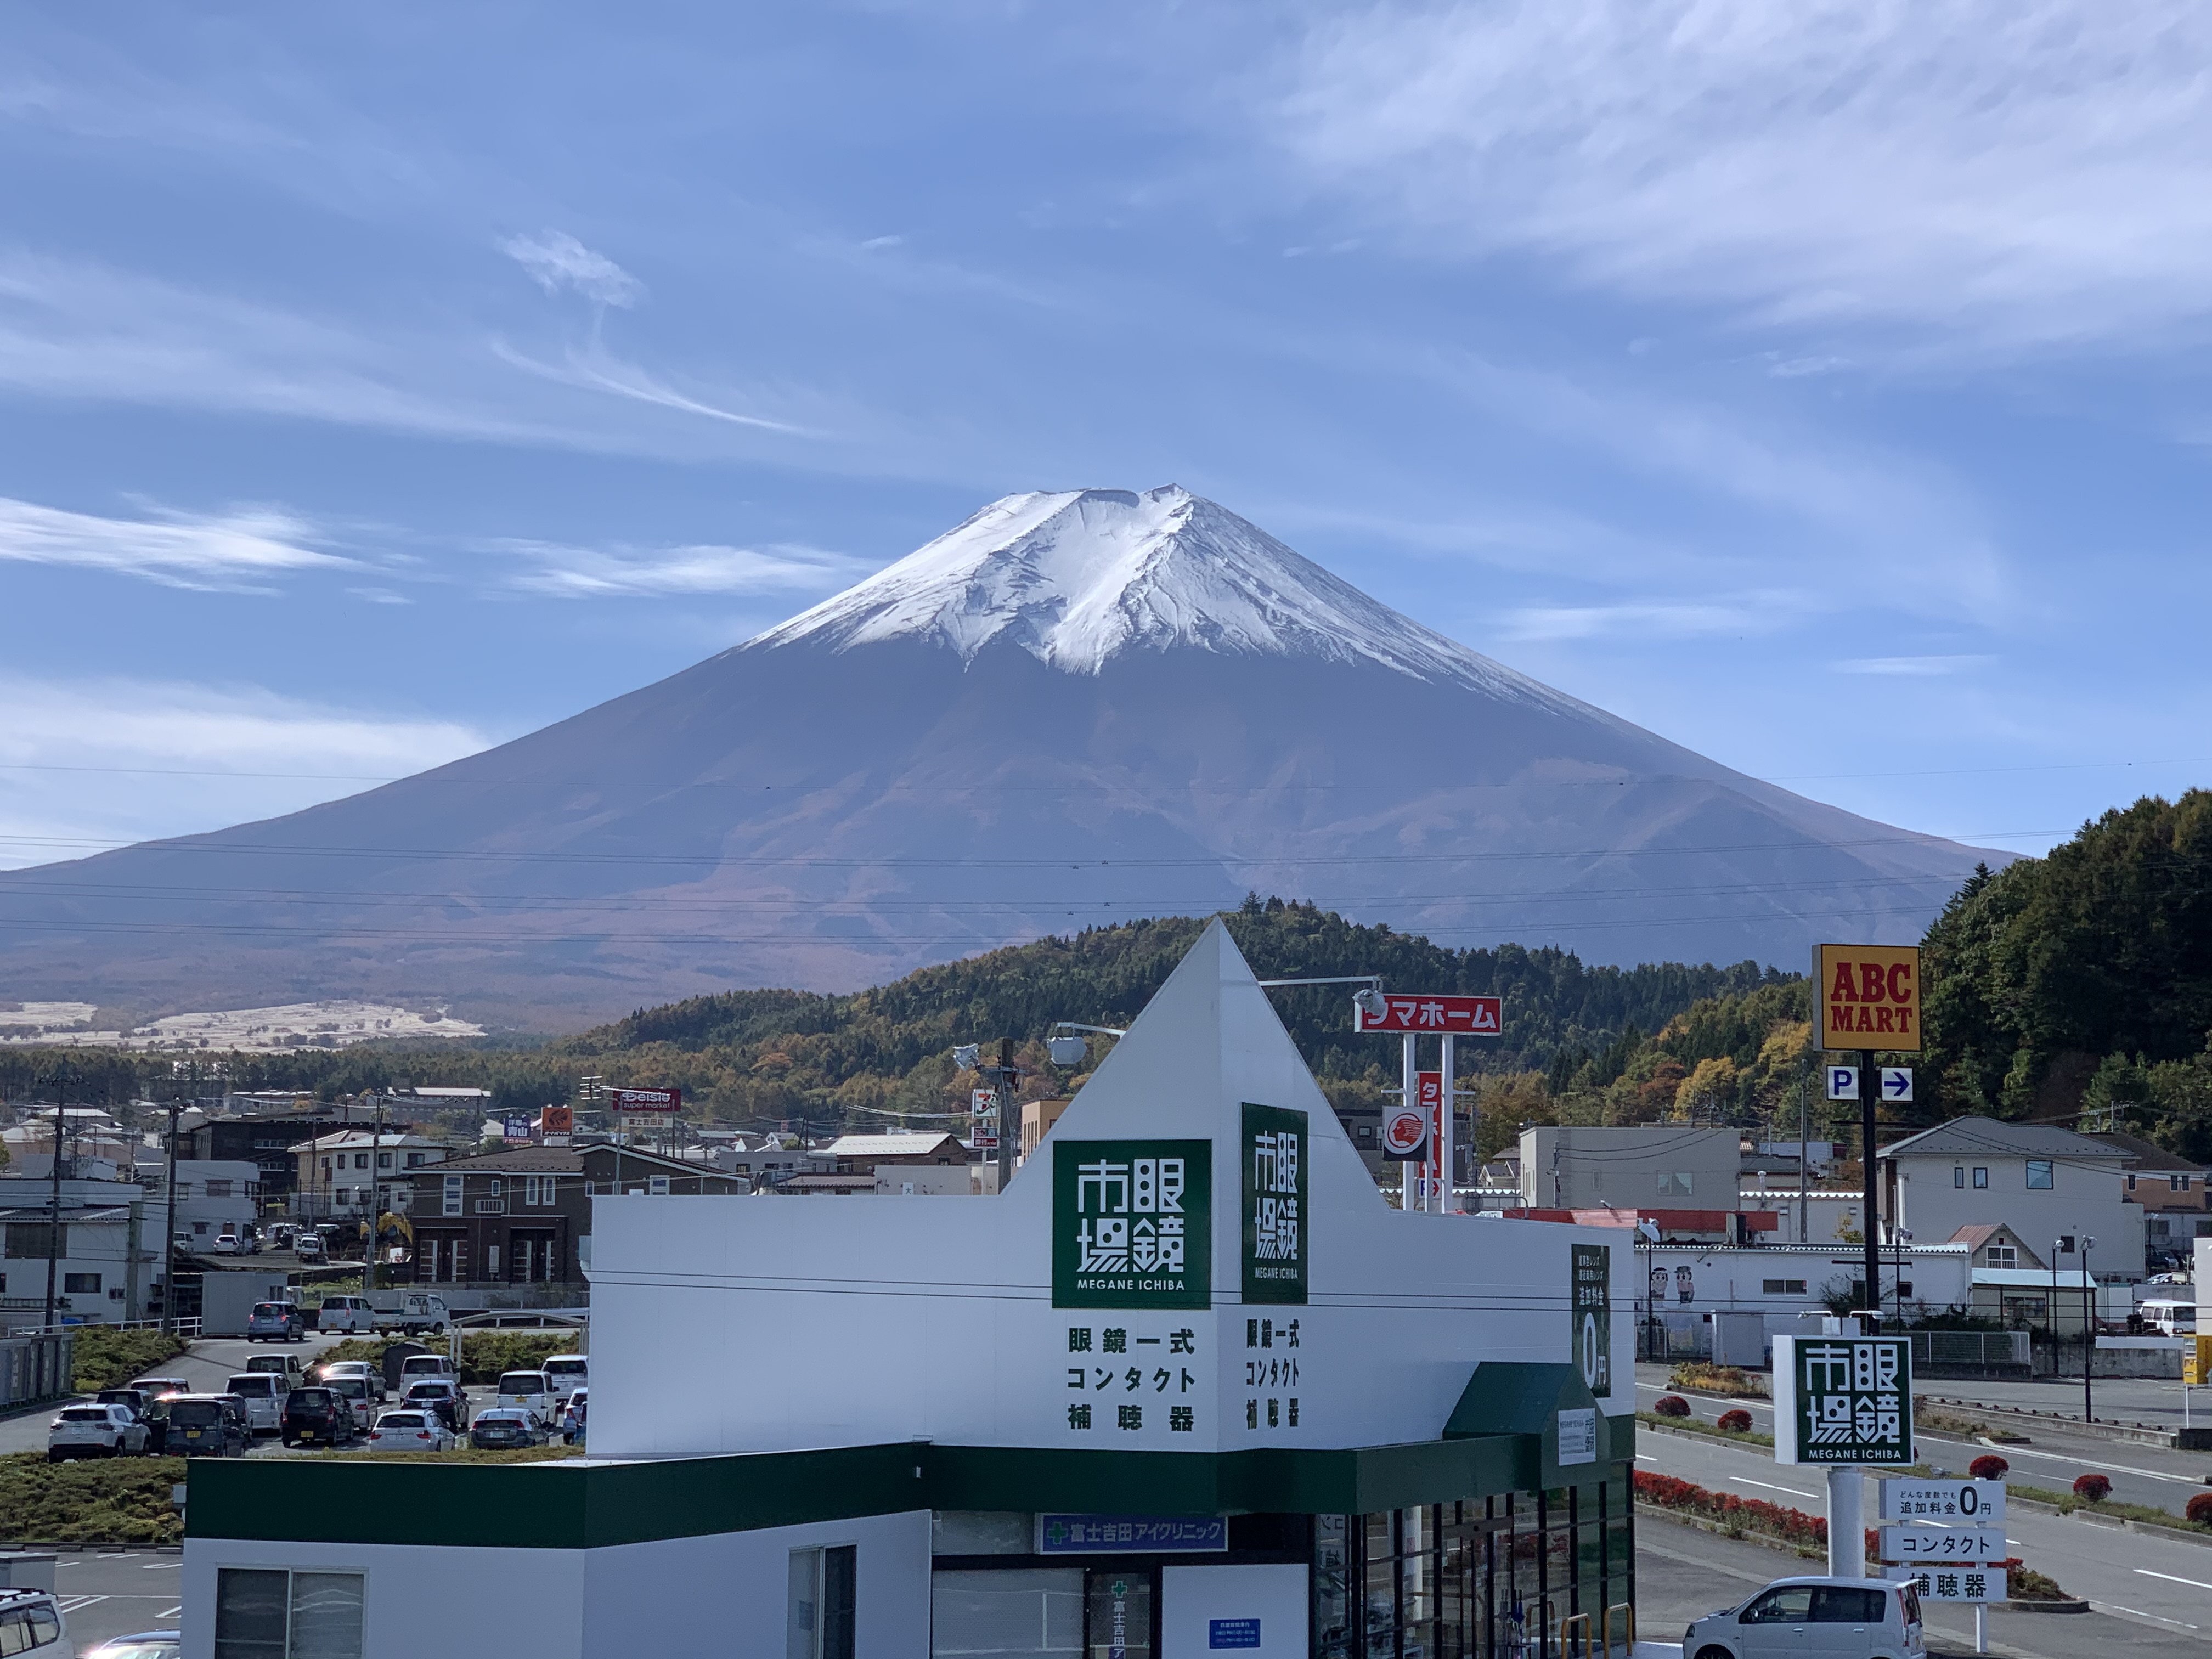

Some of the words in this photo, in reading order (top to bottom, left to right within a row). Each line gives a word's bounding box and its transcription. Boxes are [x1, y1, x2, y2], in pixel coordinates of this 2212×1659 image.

[1831, 963, 1911, 1003] ABC
[1831, 1006, 1912, 1033] MART
[1833, 1070, 1852, 1096] P
[1077, 1280, 1133, 1290] MEGANE
[1139, 1280, 1184, 1290] ICHIBA
[1255, 1267, 1278, 1279] MEGANE
[1280, 1268, 1298, 1279] ICHIBA
[1069, 1328, 1195, 1354] 眼鏡一式
[1247, 1319, 1299, 1348] 眼鏡一式
[1068, 1367, 1195, 1392] コンタクト
[1246, 1358, 1299, 1387] コンタクト
[1068, 1404, 1194, 1431] 補聴器
[1247, 1398, 1298, 1430] 補聴器
[1809, 1449, 1857, 1459] MEGANE
[1862, 1449, 1901, 1459] ICHIBA
[1901, 1502, 1956, 1514] 追加料金
[1071, 1522, 1221, 1542] 富士吉田アイクリニック
[1903, 1536, 1990, 1554] コンタクト
